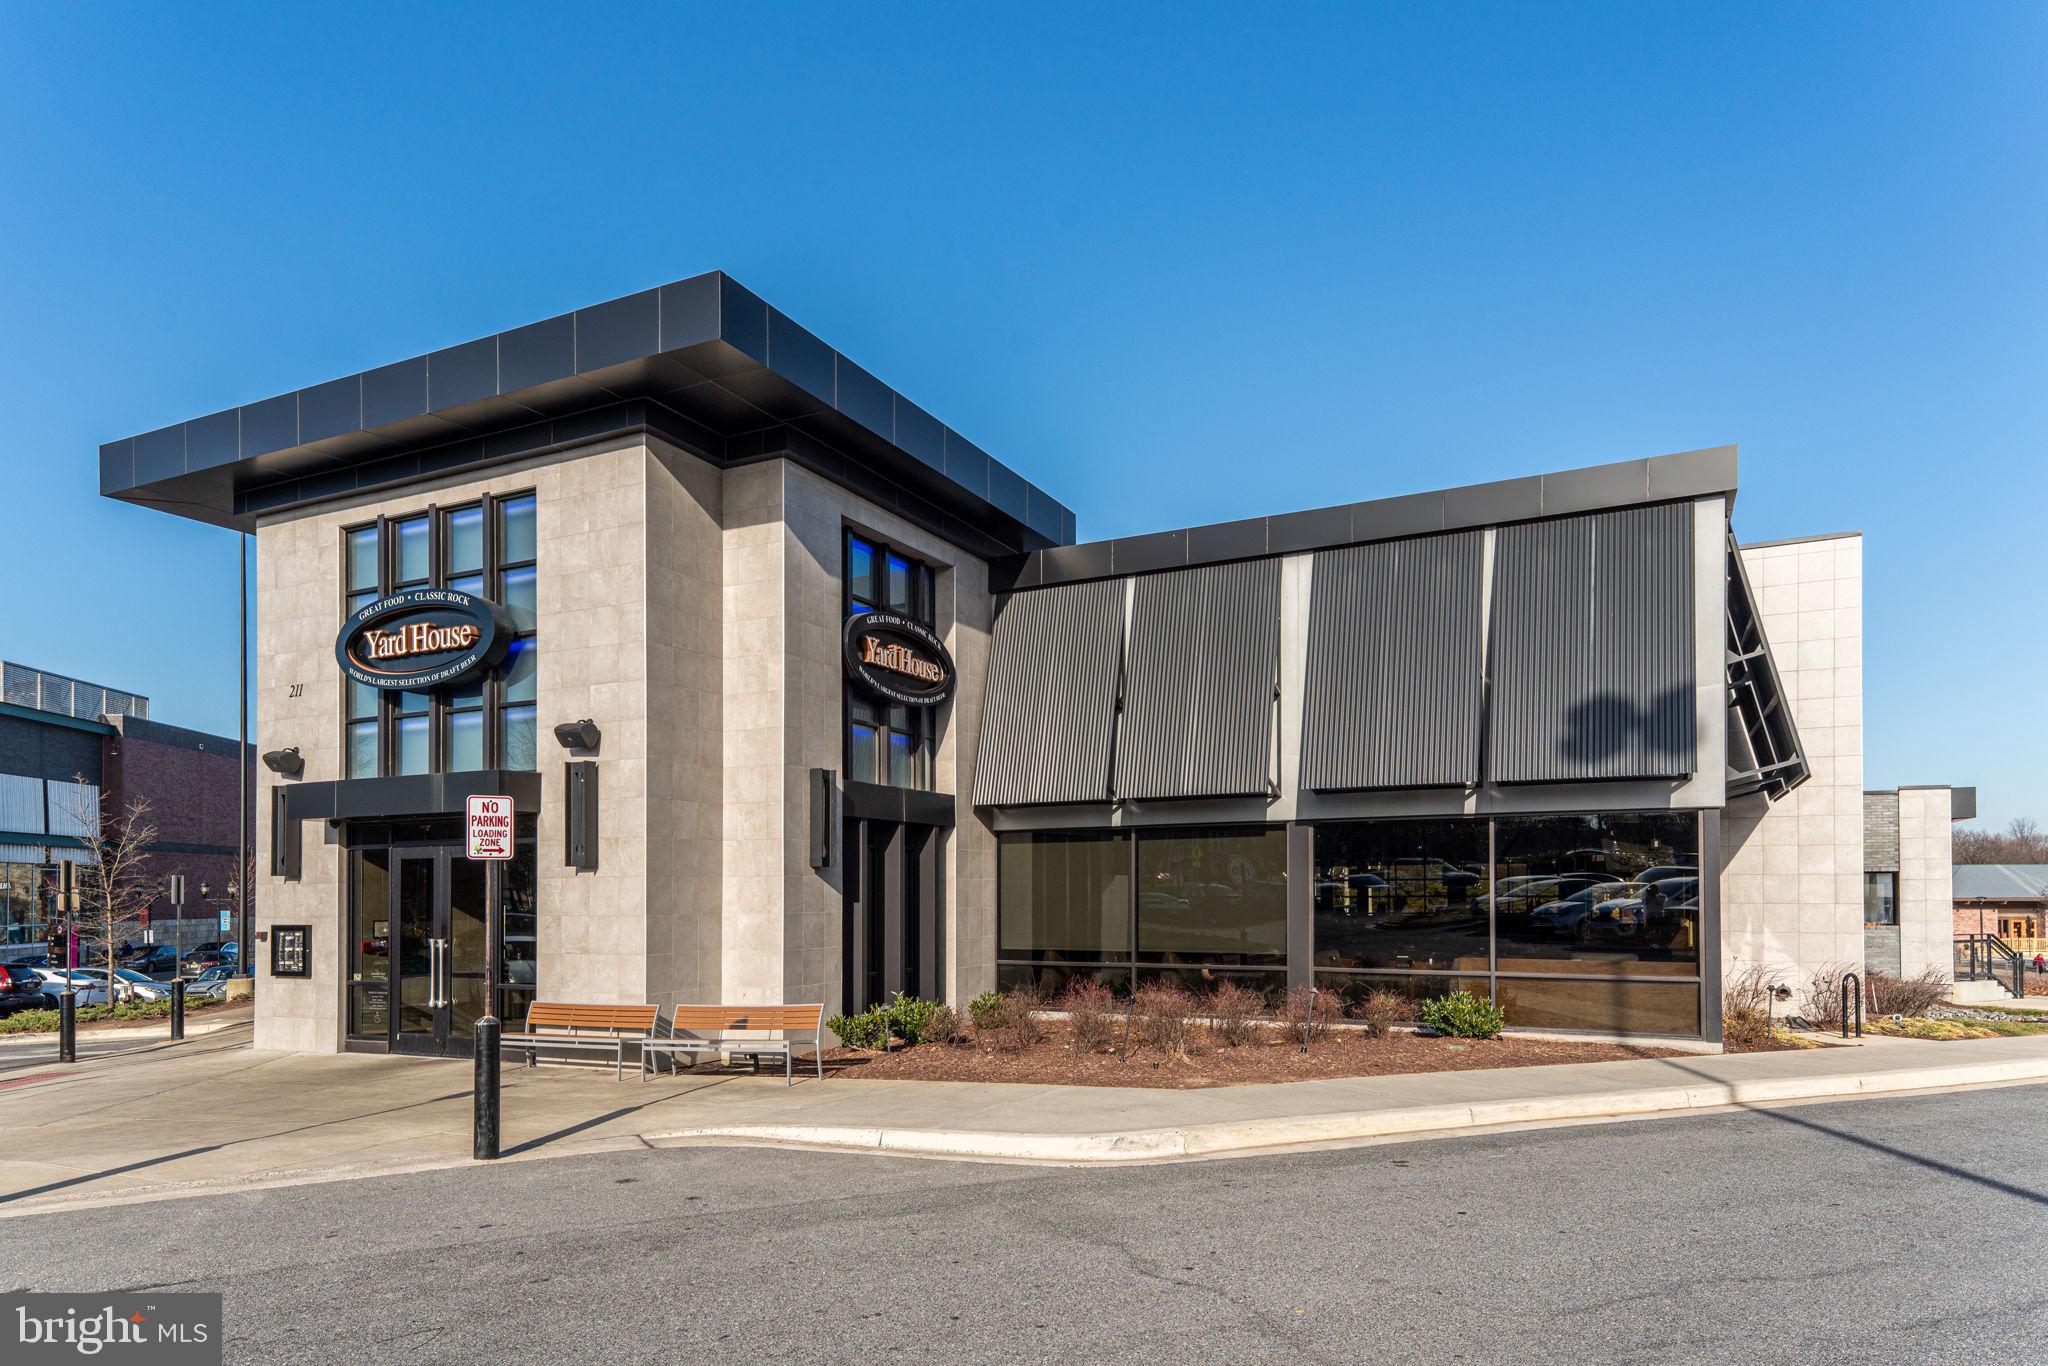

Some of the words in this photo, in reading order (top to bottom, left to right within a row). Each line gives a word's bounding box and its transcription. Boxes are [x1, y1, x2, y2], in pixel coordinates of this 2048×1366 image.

[359, 602, 383, 620] GREAT
[383, 595, 405, 608] FOOD
[415, 591, 446, 601] CLASSIC
[447, 593, 470, 606] ROCK
[866, 615, 885, 625] GREAT
[885, 615, 901, 625] FOOD
[364, 625, 406, 659] Yard
[410, 622, 474, 652] House
[865, 635, 898, 669] Yard
[900, 648, 940, 681] House
[349, 667, 372, 683] WORLD'S
[372, 677, 398, 686] LARGEST
[398, 676, 431, 686] SELECTION
[431, 672, 440, 681] OF
[440, 664, 460, 679] DRAFT
[460, 654, 477, 669] BEER
[289, 684, 304, 698] 211
[482, 802, 499, 814] NO
[471, 815, 509, 827] PARKING
[473, 829, 507, 838] LOADING
[480, 838, 501, 847] ZONE
